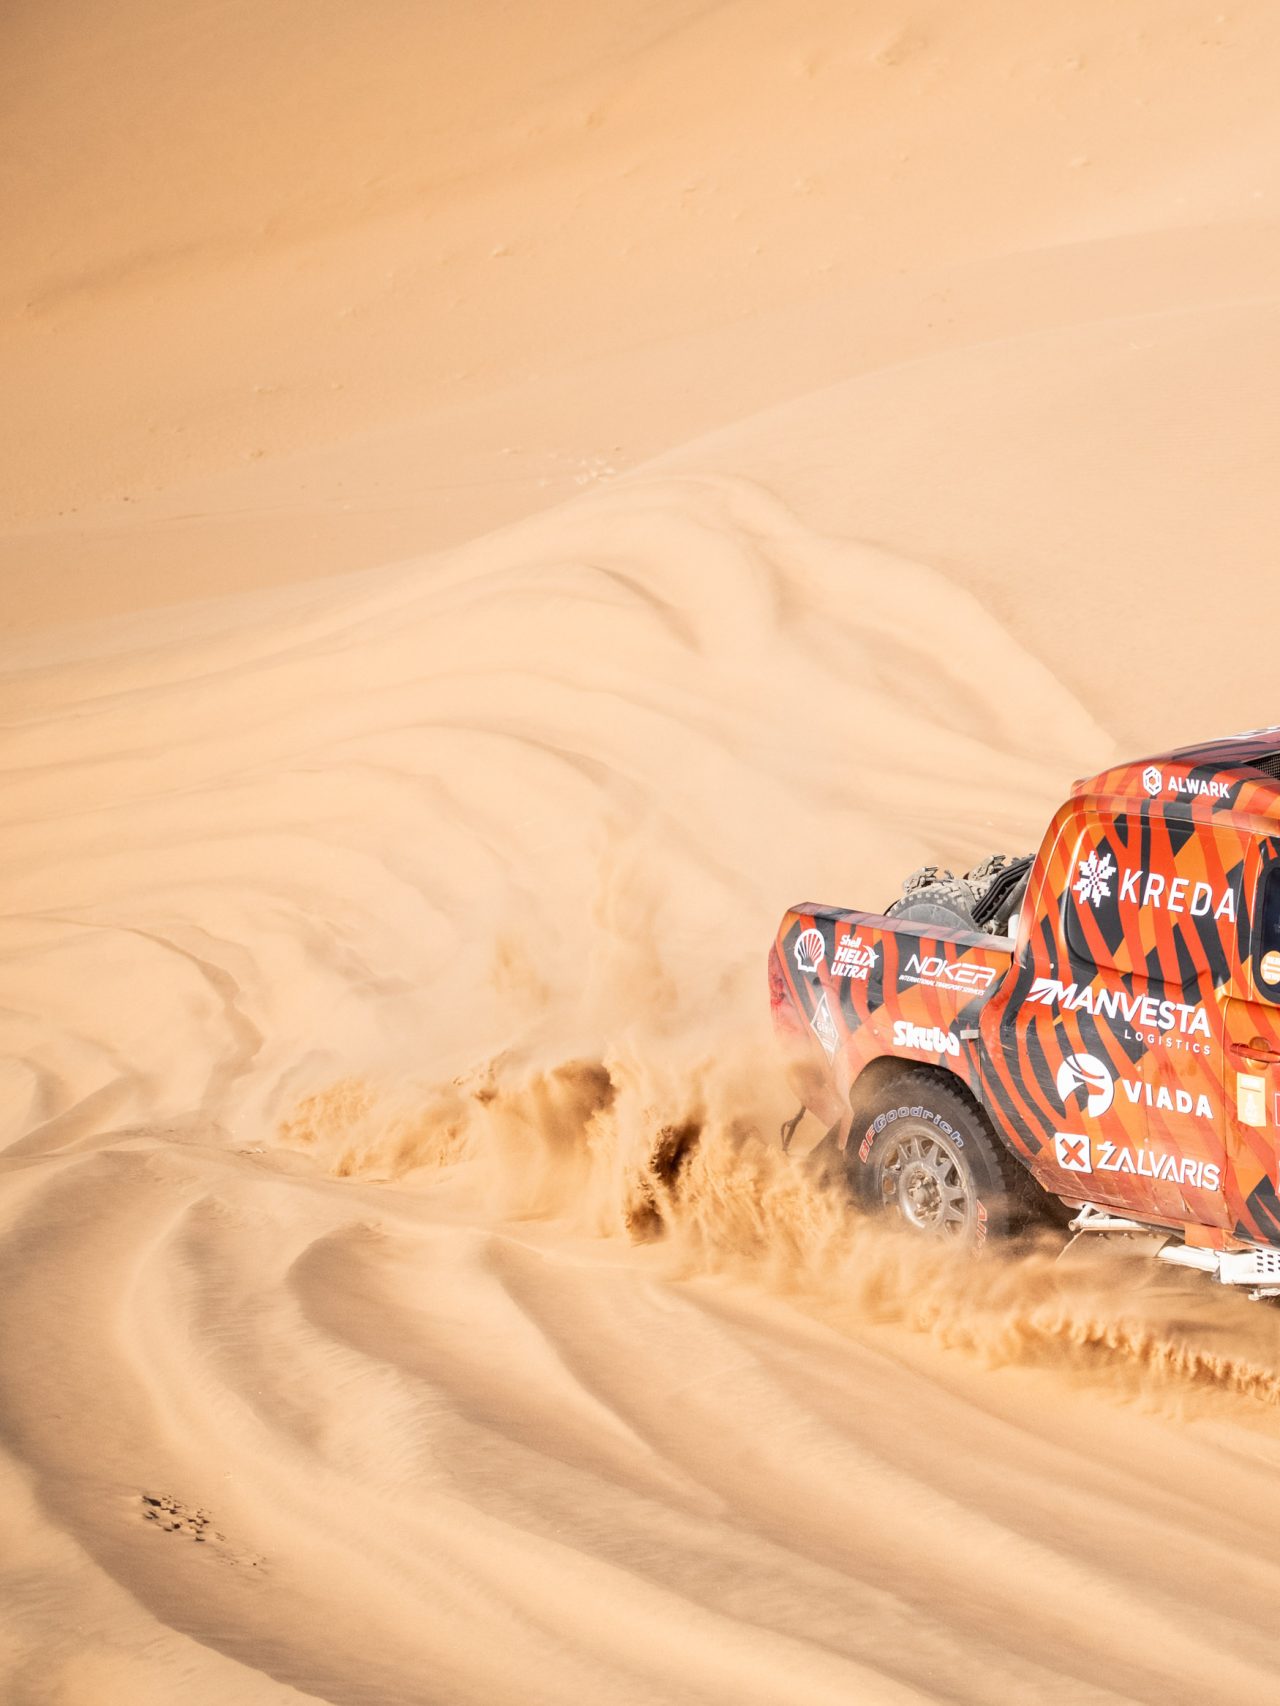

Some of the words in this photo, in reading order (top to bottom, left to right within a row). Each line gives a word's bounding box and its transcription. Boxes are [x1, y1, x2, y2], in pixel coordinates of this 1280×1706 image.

[1168, 776, 1231, 798] ALWARK
[1119, 868, 1237, 923] KREDA
[834, 945, 879, 968] HELIX
[840, 935, 862, 949] Shell
[831, 962, 868, 980] ULTRA
[1040, 979, 1212, 1038] MANVESTA
[893, 1021, 960, 1056] Skuba
[1124, 1029, 1212, 1056] LOGISTICS
[1122, 1080, 1214, 1119] VIADA
[858, 1106, 965, 1163] BFGoodrich
[1096, 1141, 1221, 1190] ŽALVARIS
